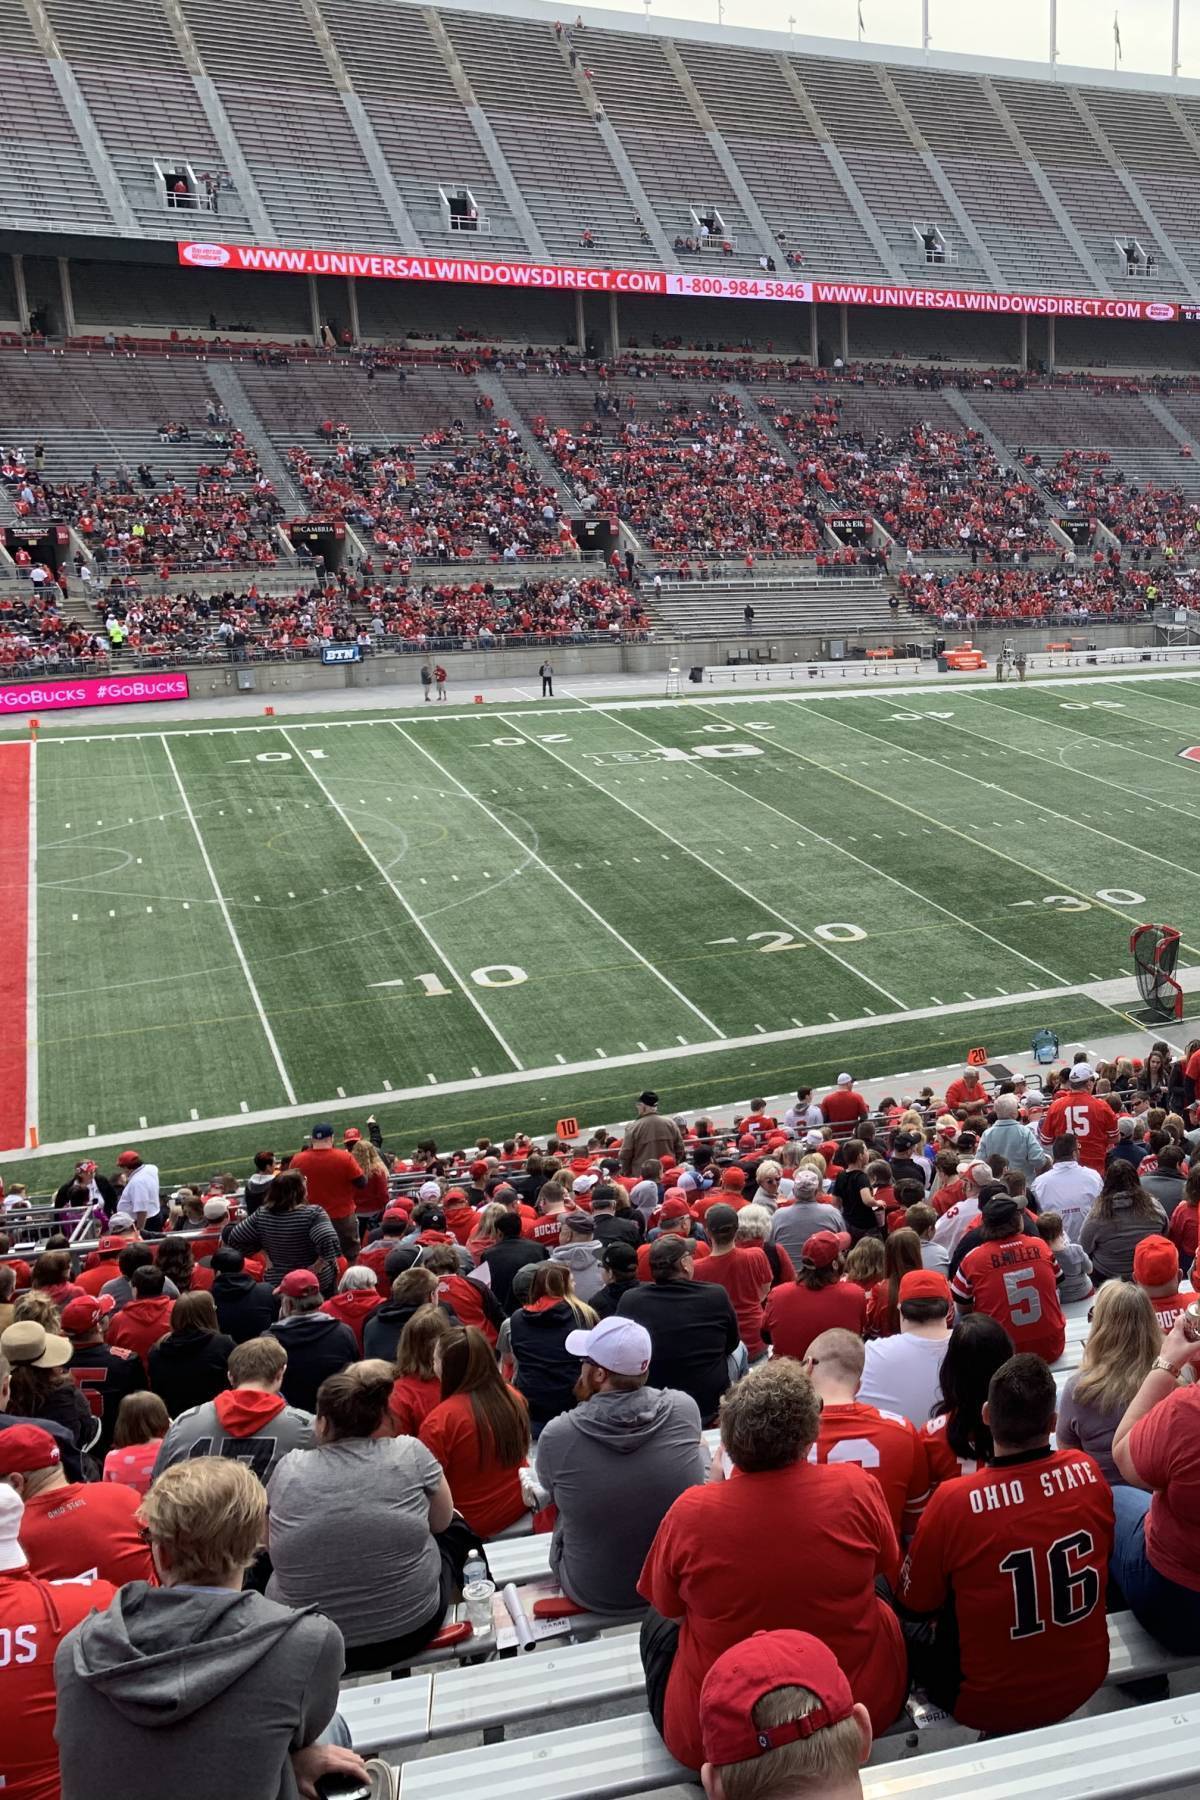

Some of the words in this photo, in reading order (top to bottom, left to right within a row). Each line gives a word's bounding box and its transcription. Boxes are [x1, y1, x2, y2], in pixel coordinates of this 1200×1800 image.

[238, 248, 661, 292] WWW.UNIVERSALWINDOWSDIRECT.COM
[676, 277, 805, 298] 1-800-984-5846
[817, 285, 1141, 317] WWW.UNIVERSALWINDOWSDIRECT.COM
[833, 520, 845, 528] Elk
[325, 649, 355, 661] BTN
[1043, 888, 1147, 912] 30
[746, 922, 868, 952] 20
[412, 965, 529, 997] 10
[972, 1049, 986, 1064] 20
[560, 1118, 577, 1136] 10
[1064, 1106, 1090, 1137] 15
[1003, 1266, 1042, 1327] 5
[969, 1479, 1025, 1514] OHIO
[1040, 1461, 1098, 1497] STATE
[999, 1528, 1100, 1640] 16
